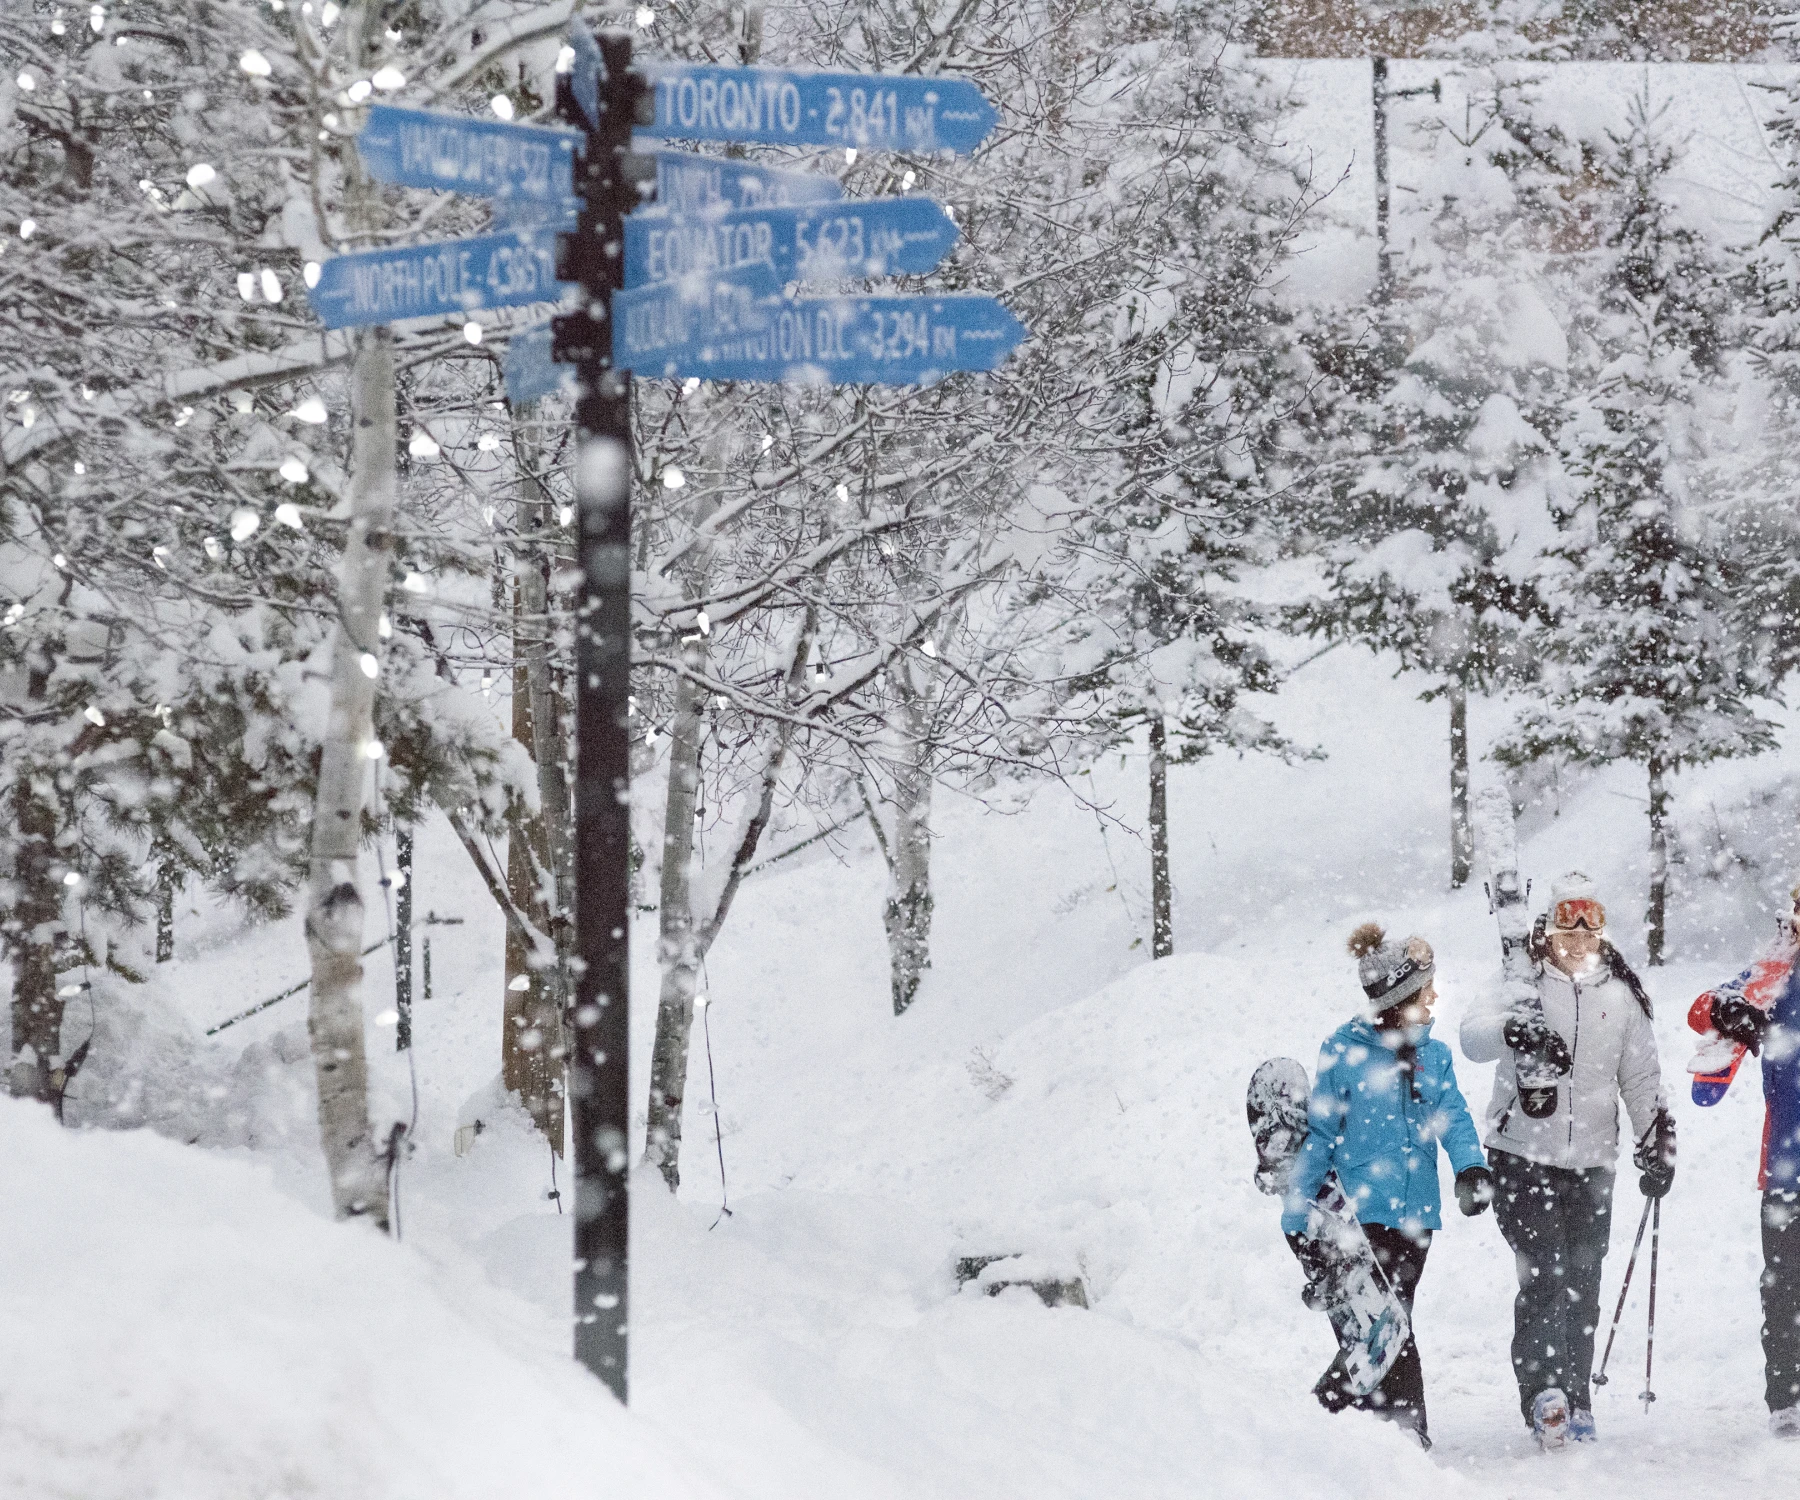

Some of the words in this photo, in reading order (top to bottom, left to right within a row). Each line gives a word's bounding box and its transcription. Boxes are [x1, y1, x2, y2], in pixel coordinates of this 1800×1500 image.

[663, 77, 800, 132] TORONTO
[353, 259, 420, 313] NORTH
[422, 251, 473, 304] POLE
